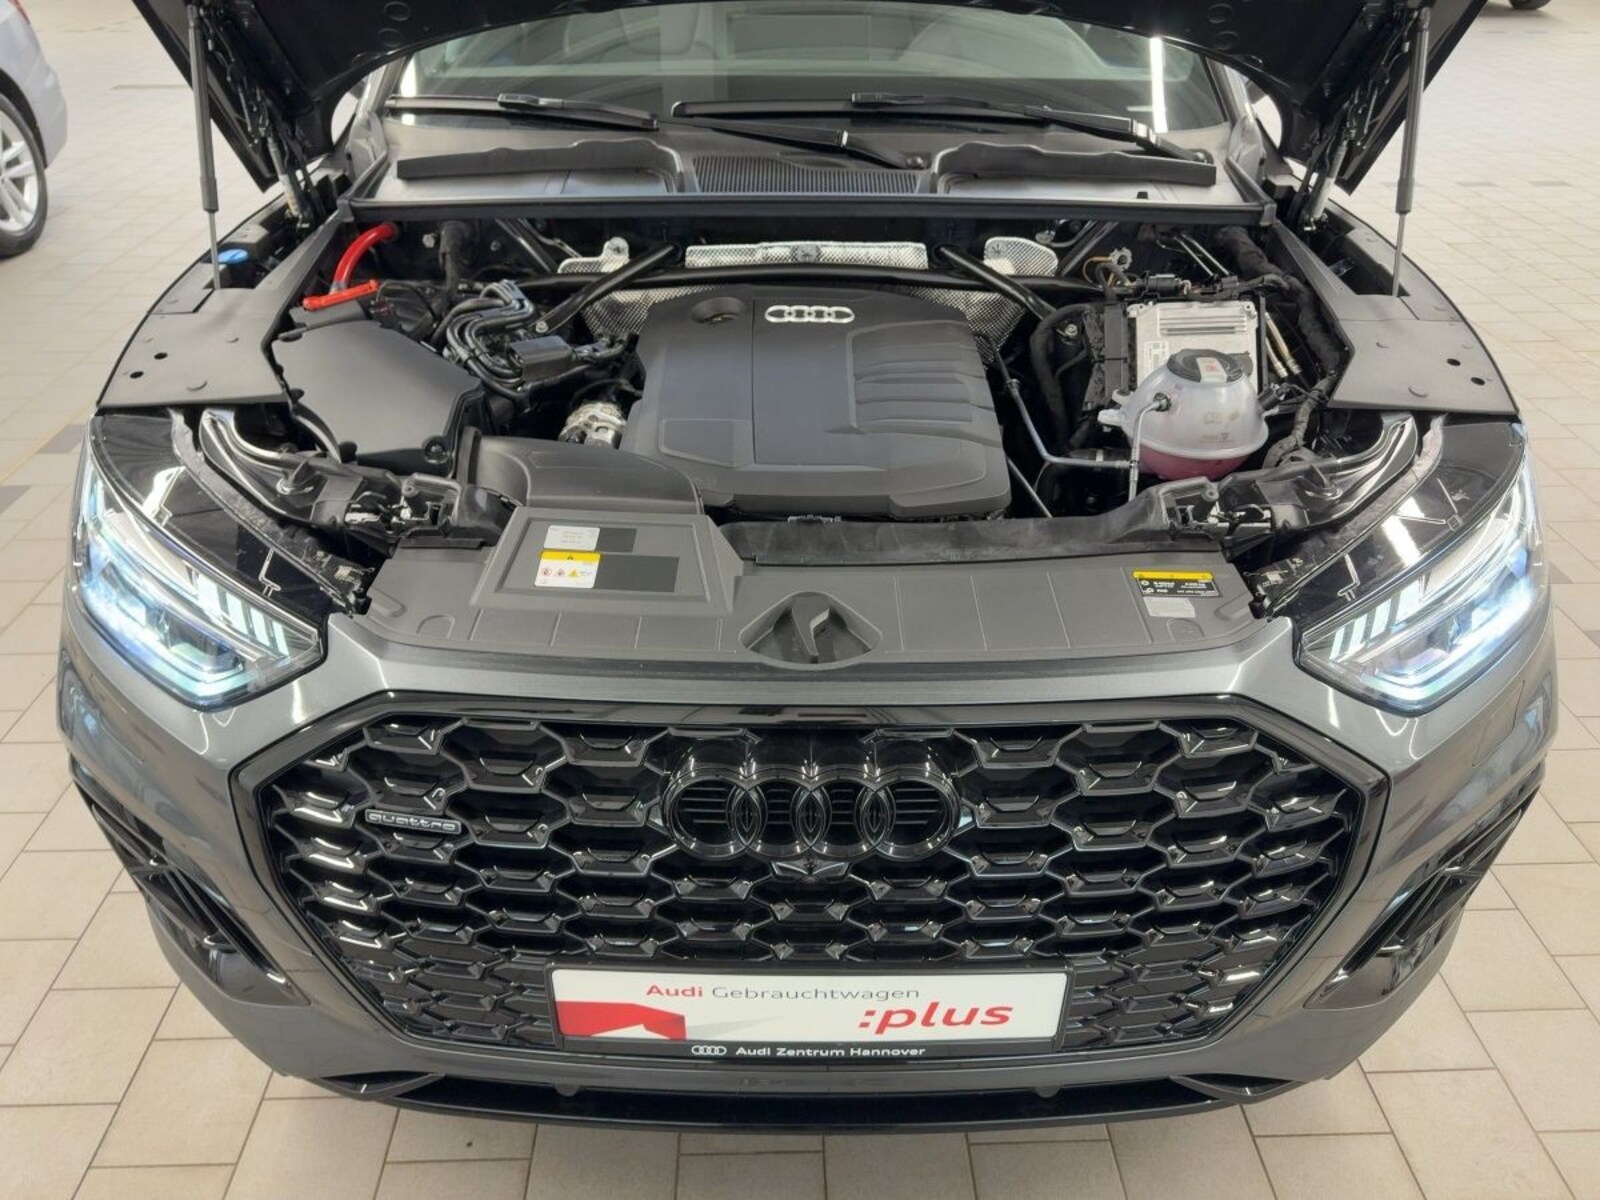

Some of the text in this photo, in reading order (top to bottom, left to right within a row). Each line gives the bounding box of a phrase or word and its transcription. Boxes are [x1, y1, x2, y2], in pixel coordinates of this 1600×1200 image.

[368, 812, 456, 831] quattro
[646, 984, 920, 1001] Audi Gebrauchtwagen
[735, 1046, 926, 1057] Audi Zentrum Hannover
